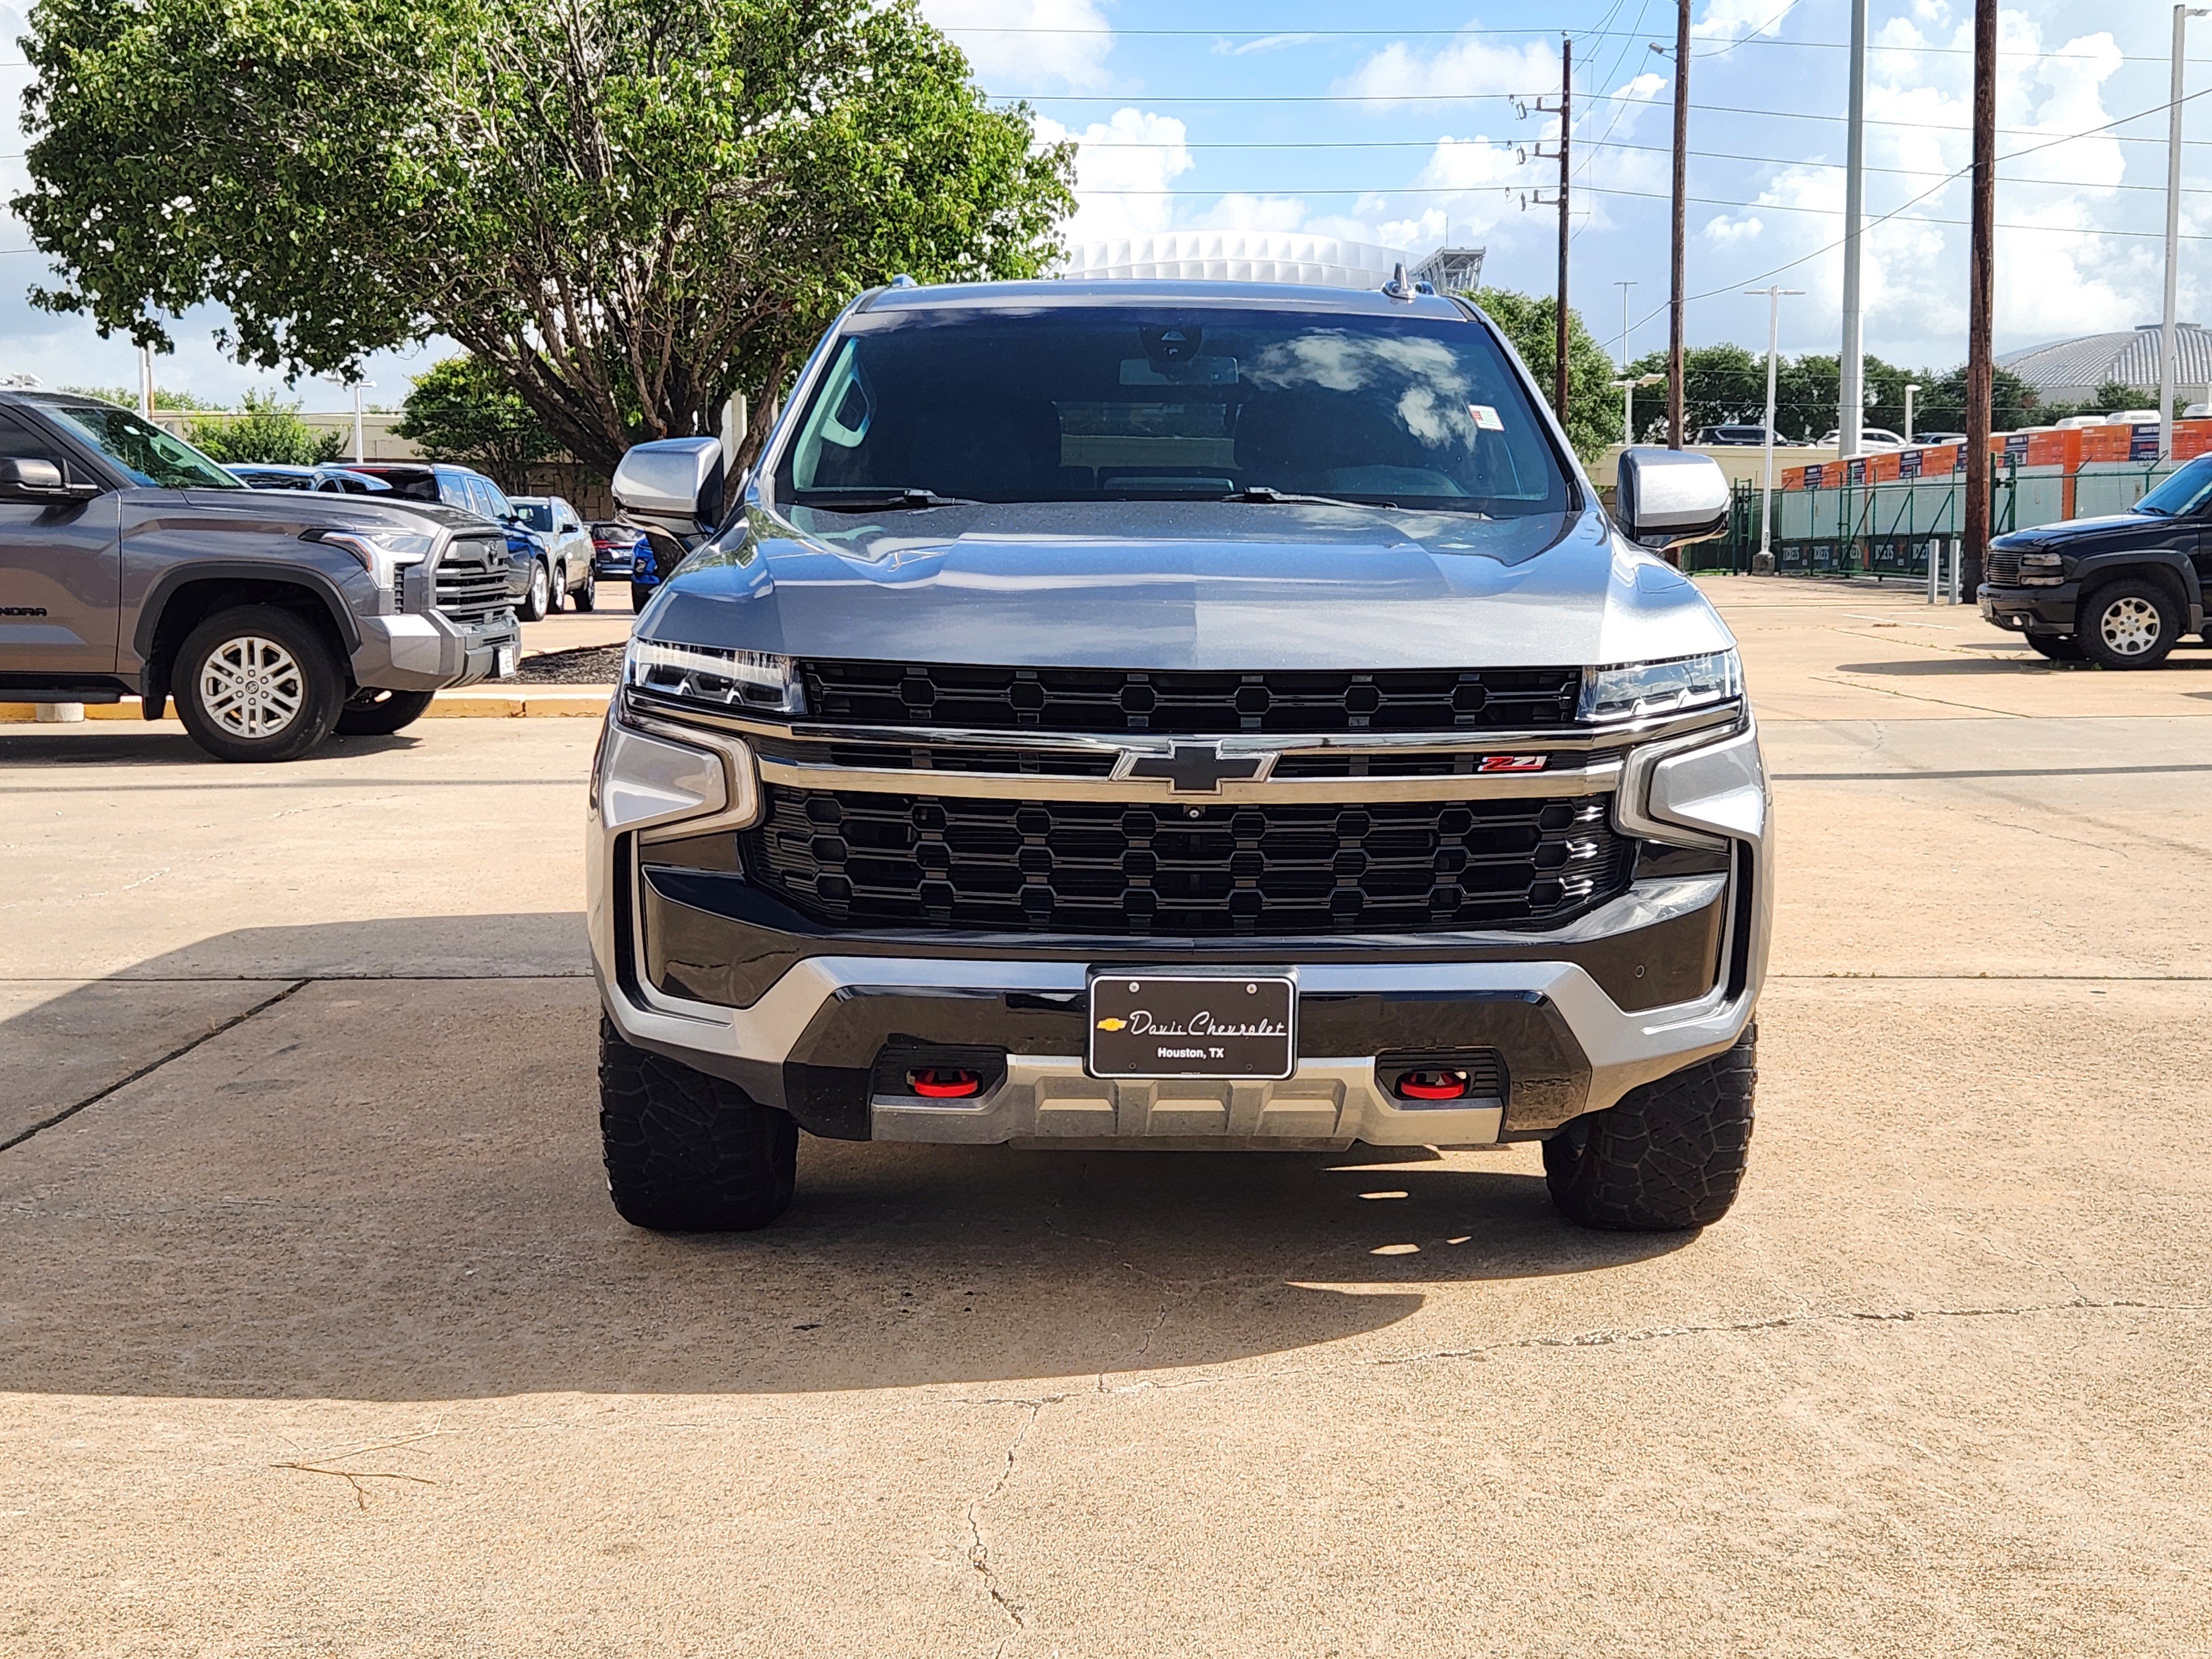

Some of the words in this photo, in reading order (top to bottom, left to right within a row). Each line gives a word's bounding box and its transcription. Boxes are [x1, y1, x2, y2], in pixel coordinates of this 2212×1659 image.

[1477, 755, 1548, 771] Z71
[1130, 1010, 1187, 1035] Davis
[1188, 1011, 1287, 1036] Chevrolet
[1157, 1047, 1207, 1060] Houston,
[1208, 1047, 1224, 1058] TX
